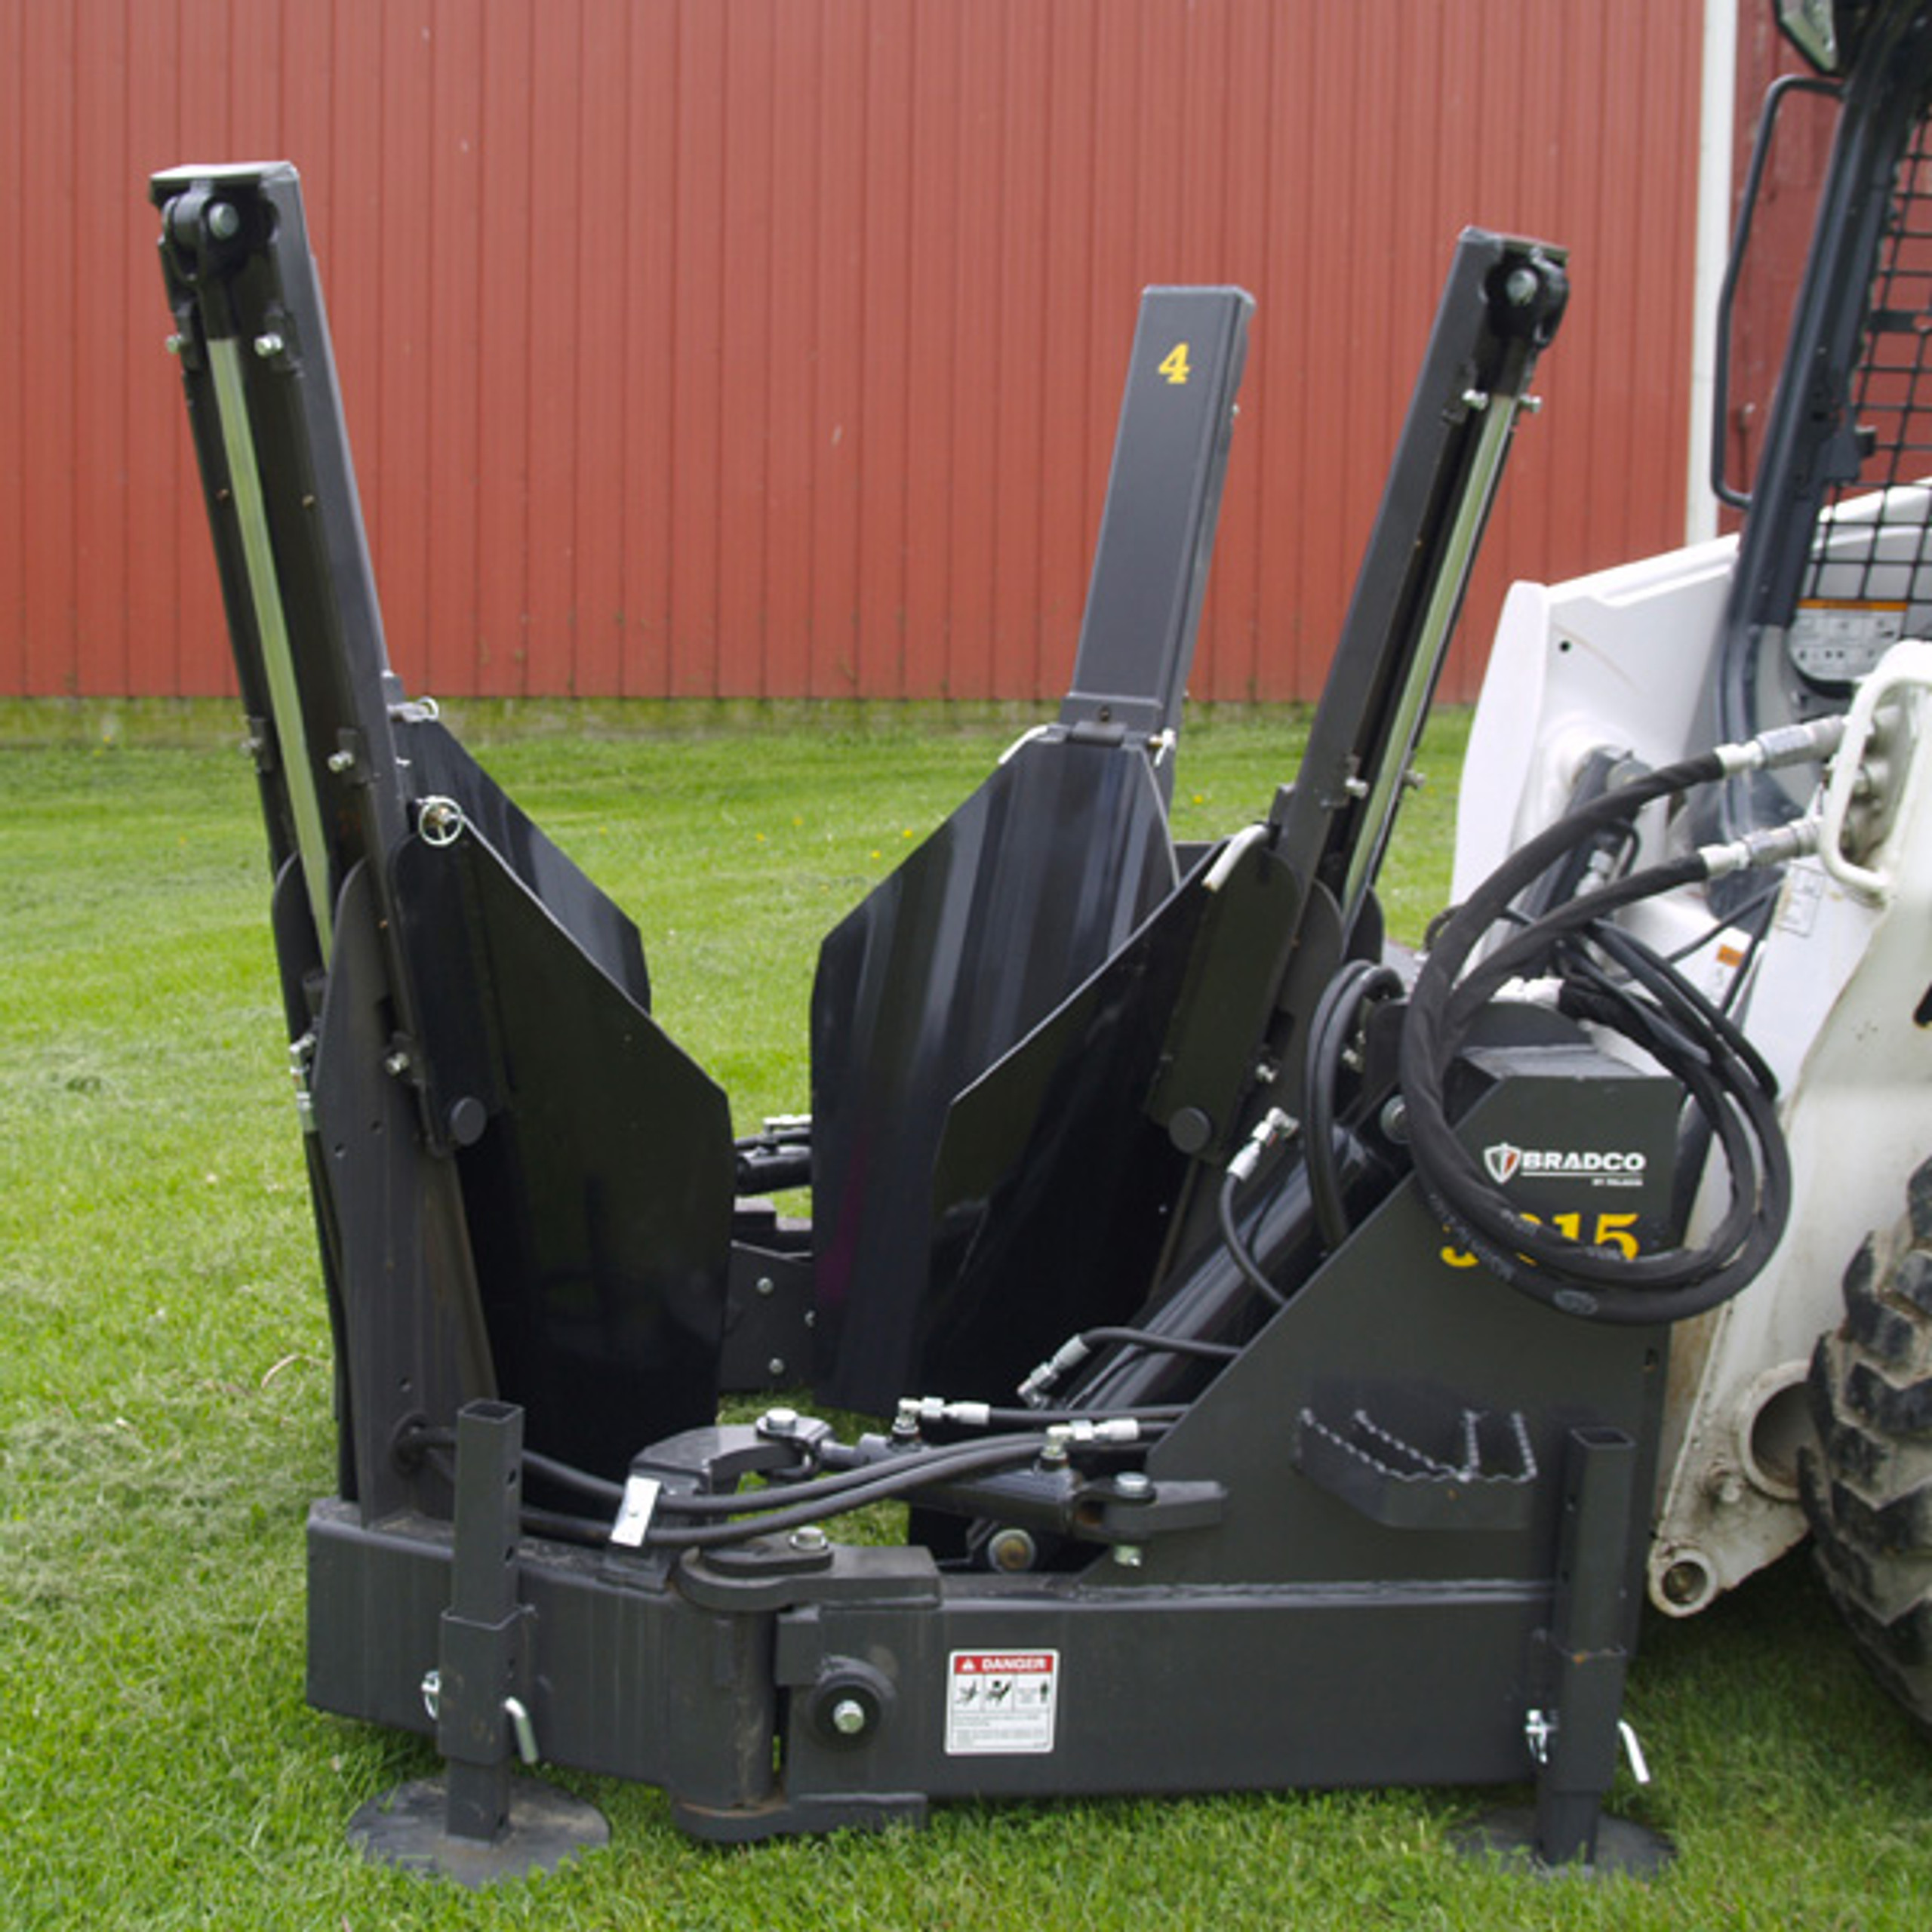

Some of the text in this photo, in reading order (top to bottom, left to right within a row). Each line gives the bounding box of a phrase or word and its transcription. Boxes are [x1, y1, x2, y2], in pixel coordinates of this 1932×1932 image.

[1158, 342, 1190, 384] 4
[1522, 1152, 1646, 1171] BRADCO
[982, 1657, 1047, 1669] DANGER
